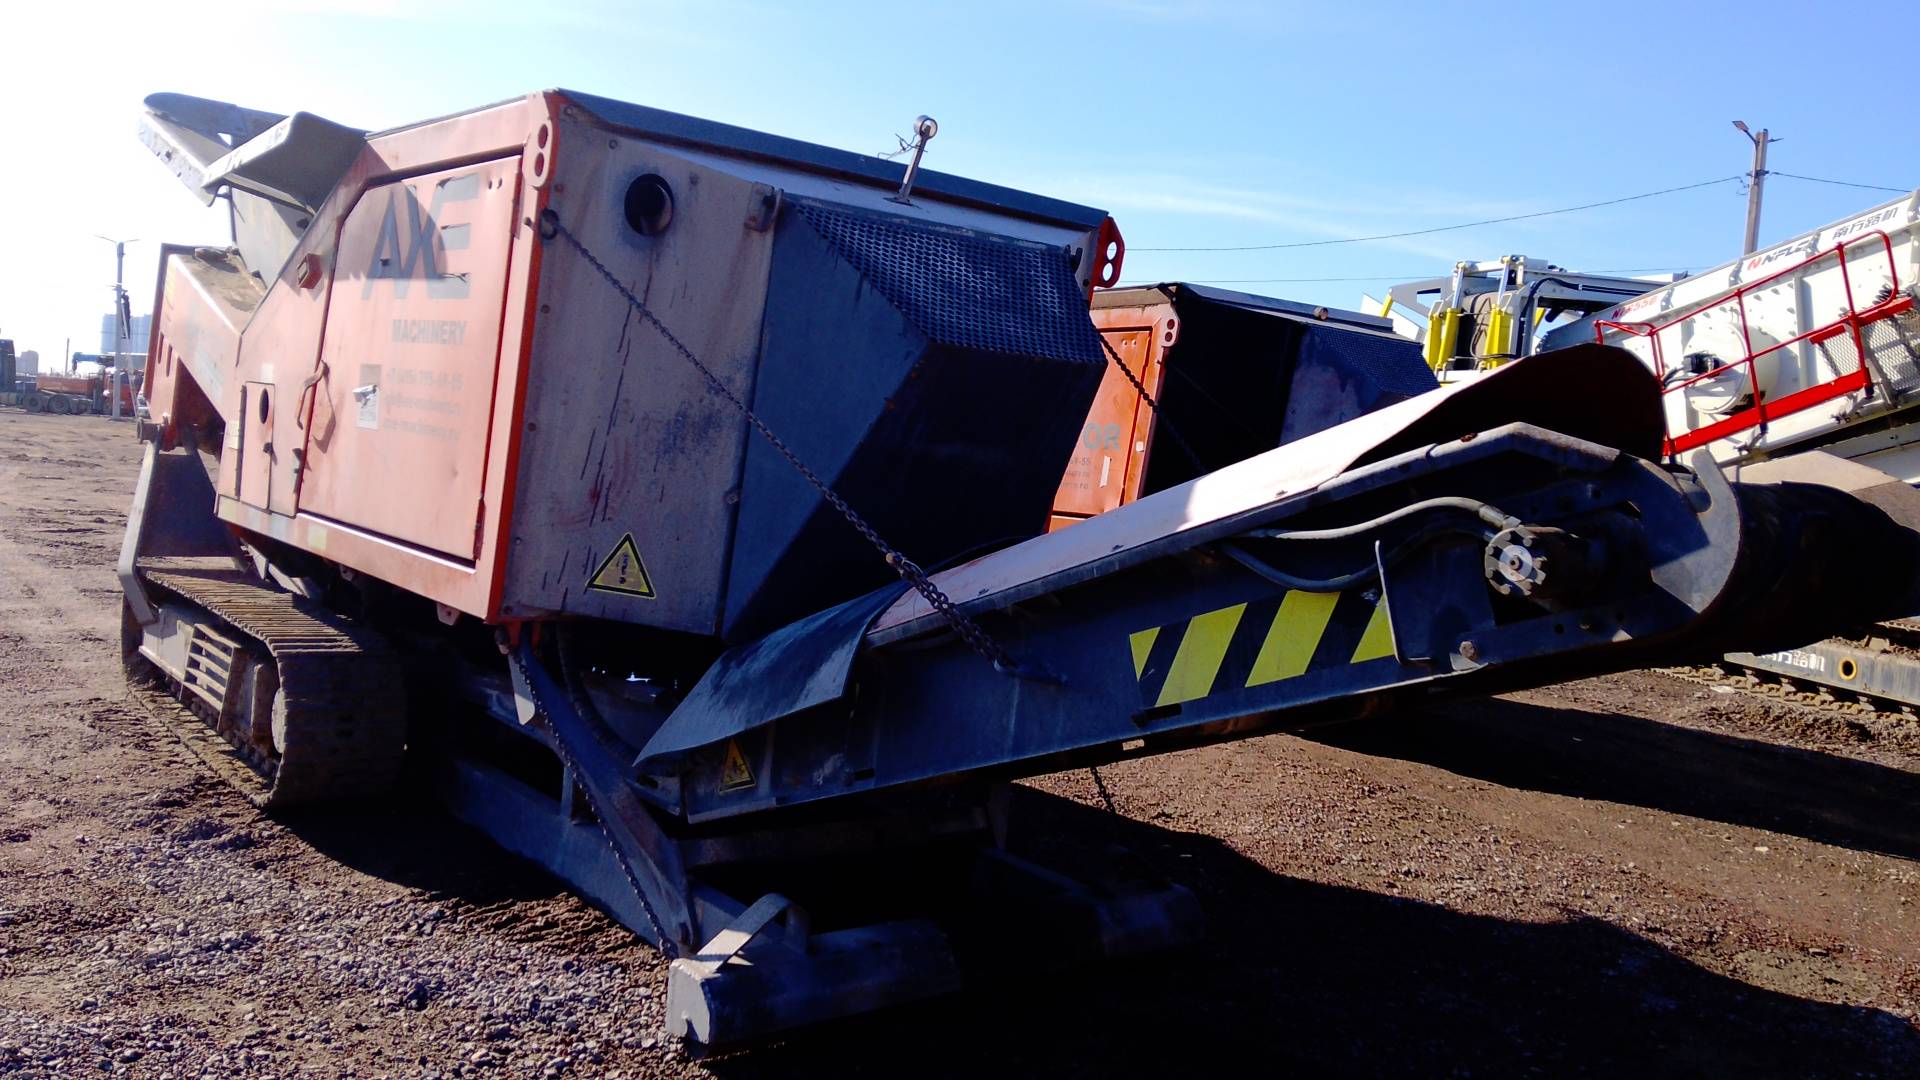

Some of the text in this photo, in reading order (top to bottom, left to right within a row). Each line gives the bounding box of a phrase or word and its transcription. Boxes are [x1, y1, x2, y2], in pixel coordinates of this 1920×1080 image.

[361, 172, 481, 301] AXE
[1832, 206, 1900, 240] 南方路机
[392, 319, 467, 345] MACHINERY
